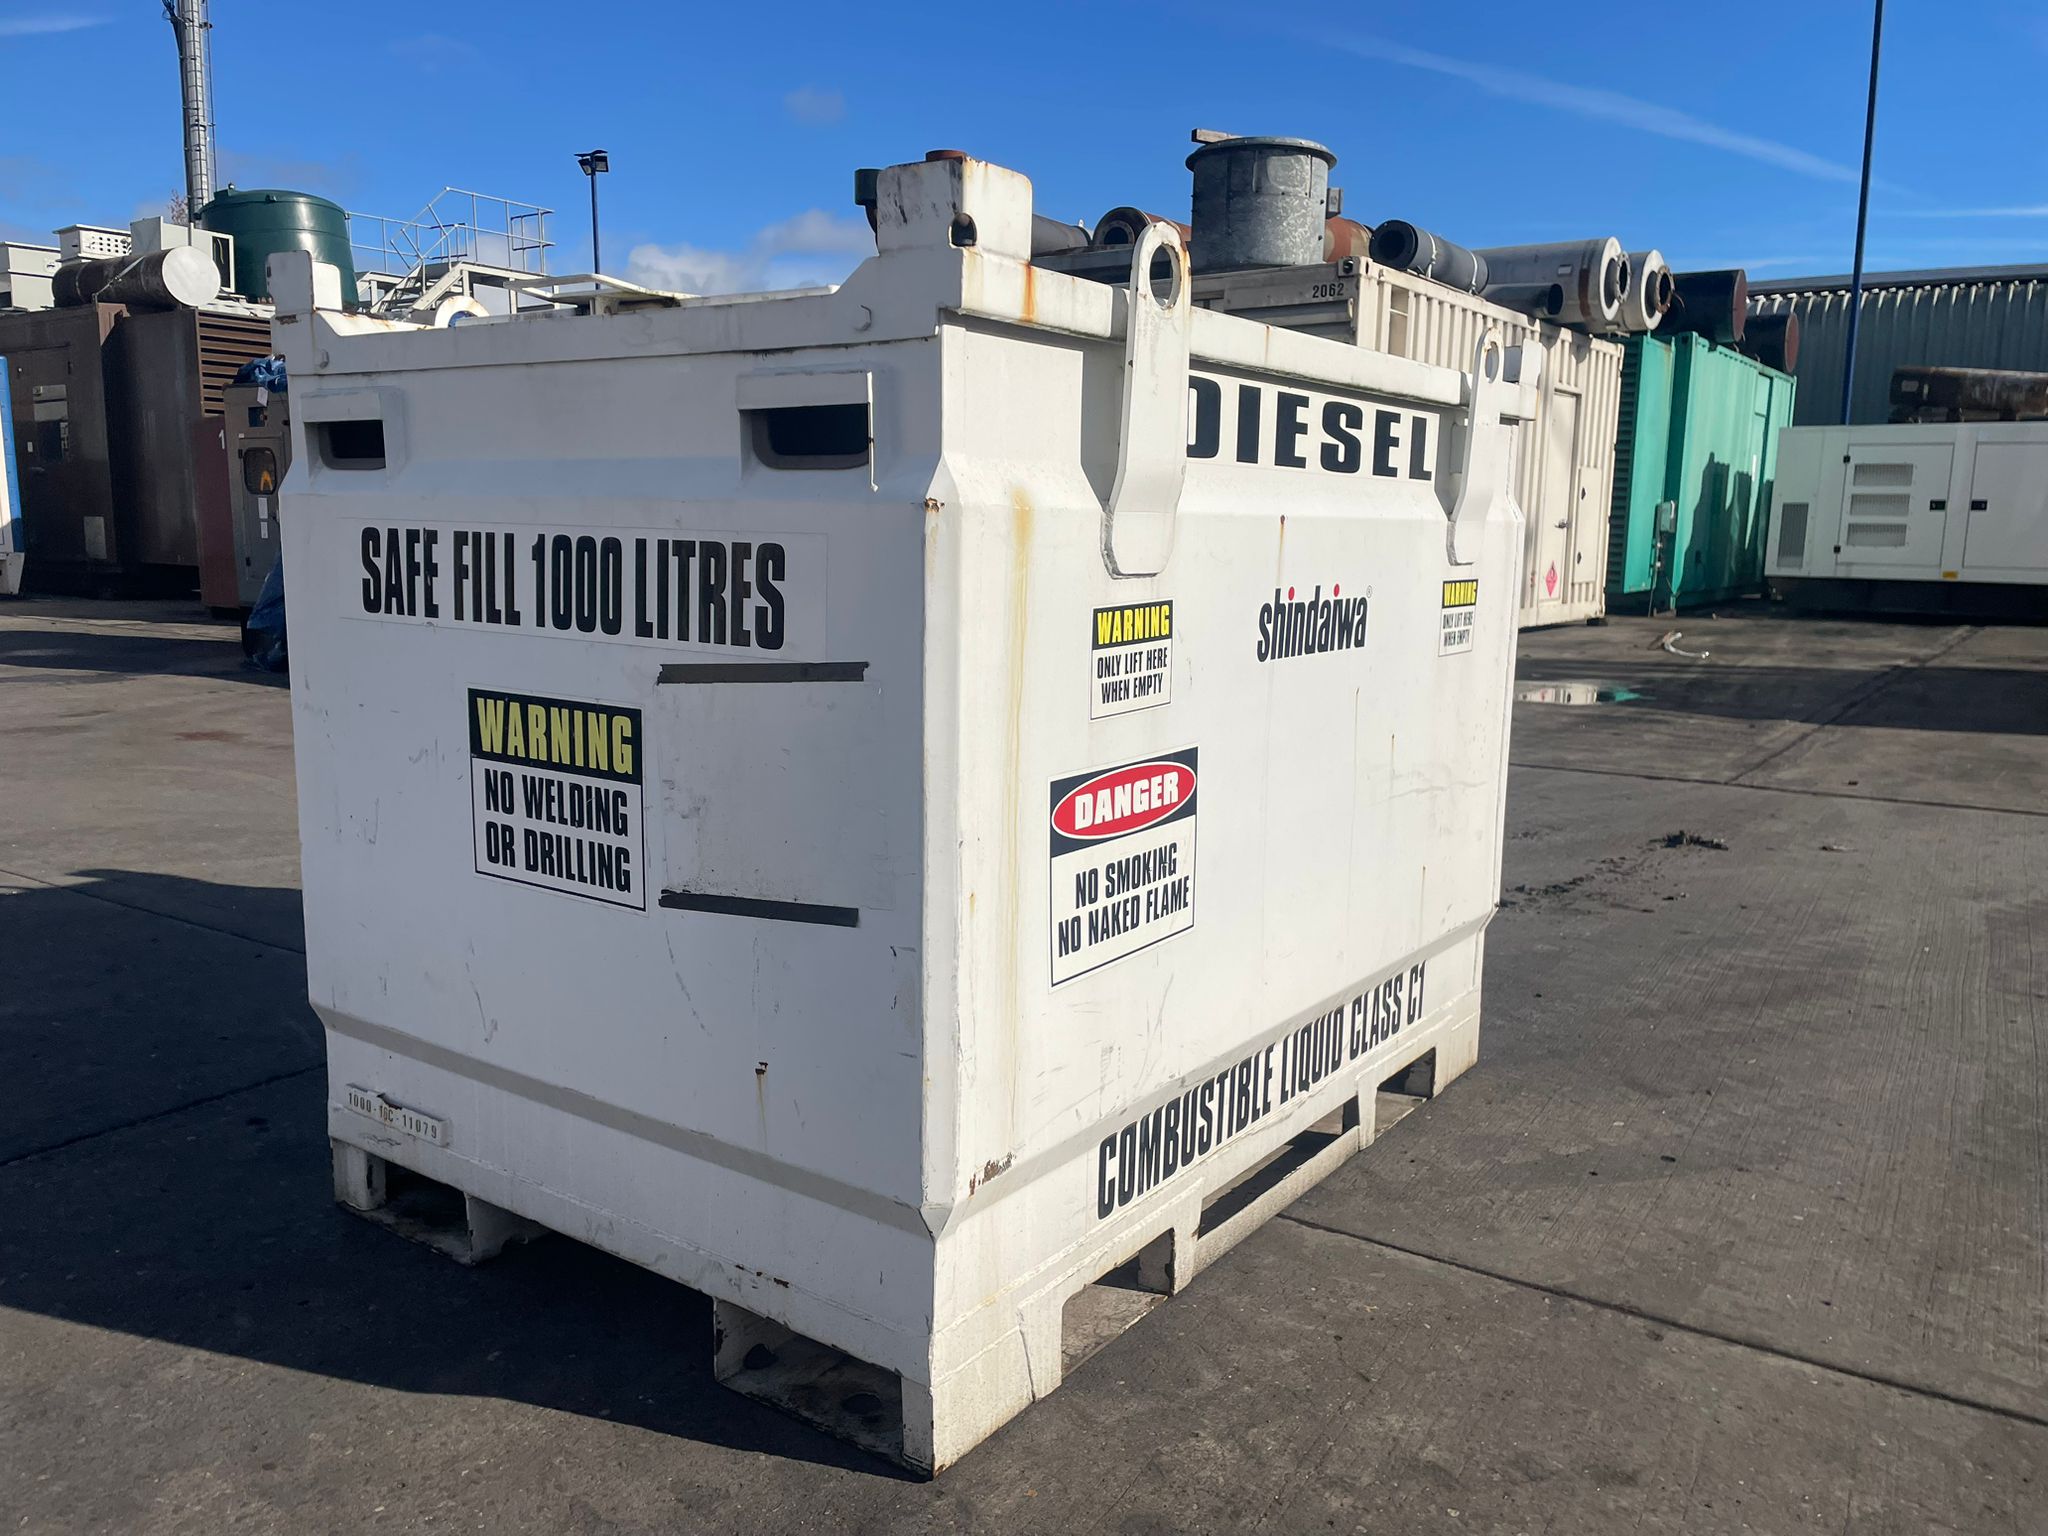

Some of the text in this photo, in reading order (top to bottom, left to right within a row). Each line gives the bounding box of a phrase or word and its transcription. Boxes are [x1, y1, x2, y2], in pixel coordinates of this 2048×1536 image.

[1312, 283, 1345, 299] 2062
[1187, 375, 1432, 481] DIESEL
[361, 527, 786, 650] SAFE FILL 1000 LITRES
[1257, 584, 1368, 662] shindaiwa
[1444, 581, 1477, 606] WARNING
[1097, 604, 1170, 645] WARNING
[1097, 647, 1168, 679] ONLY LIFT HERE
[1101, 672, 1163, 704] WHEN EMPTY
[476, 697, 633, 775] WARNING
[485, 768, 628, 837] NO WELDING
[1074, 771, 1179, 831] DANGER
[485, 820, 631, 893] OR DRILLING
[1075, 842, 1177, 909] NO SMOKING
[1058, 875, 1190, 958] NO NAKED FLAME
[1098, 960, 1426, 1220] COMBUSTIBLE LIQUID CLASS C1
